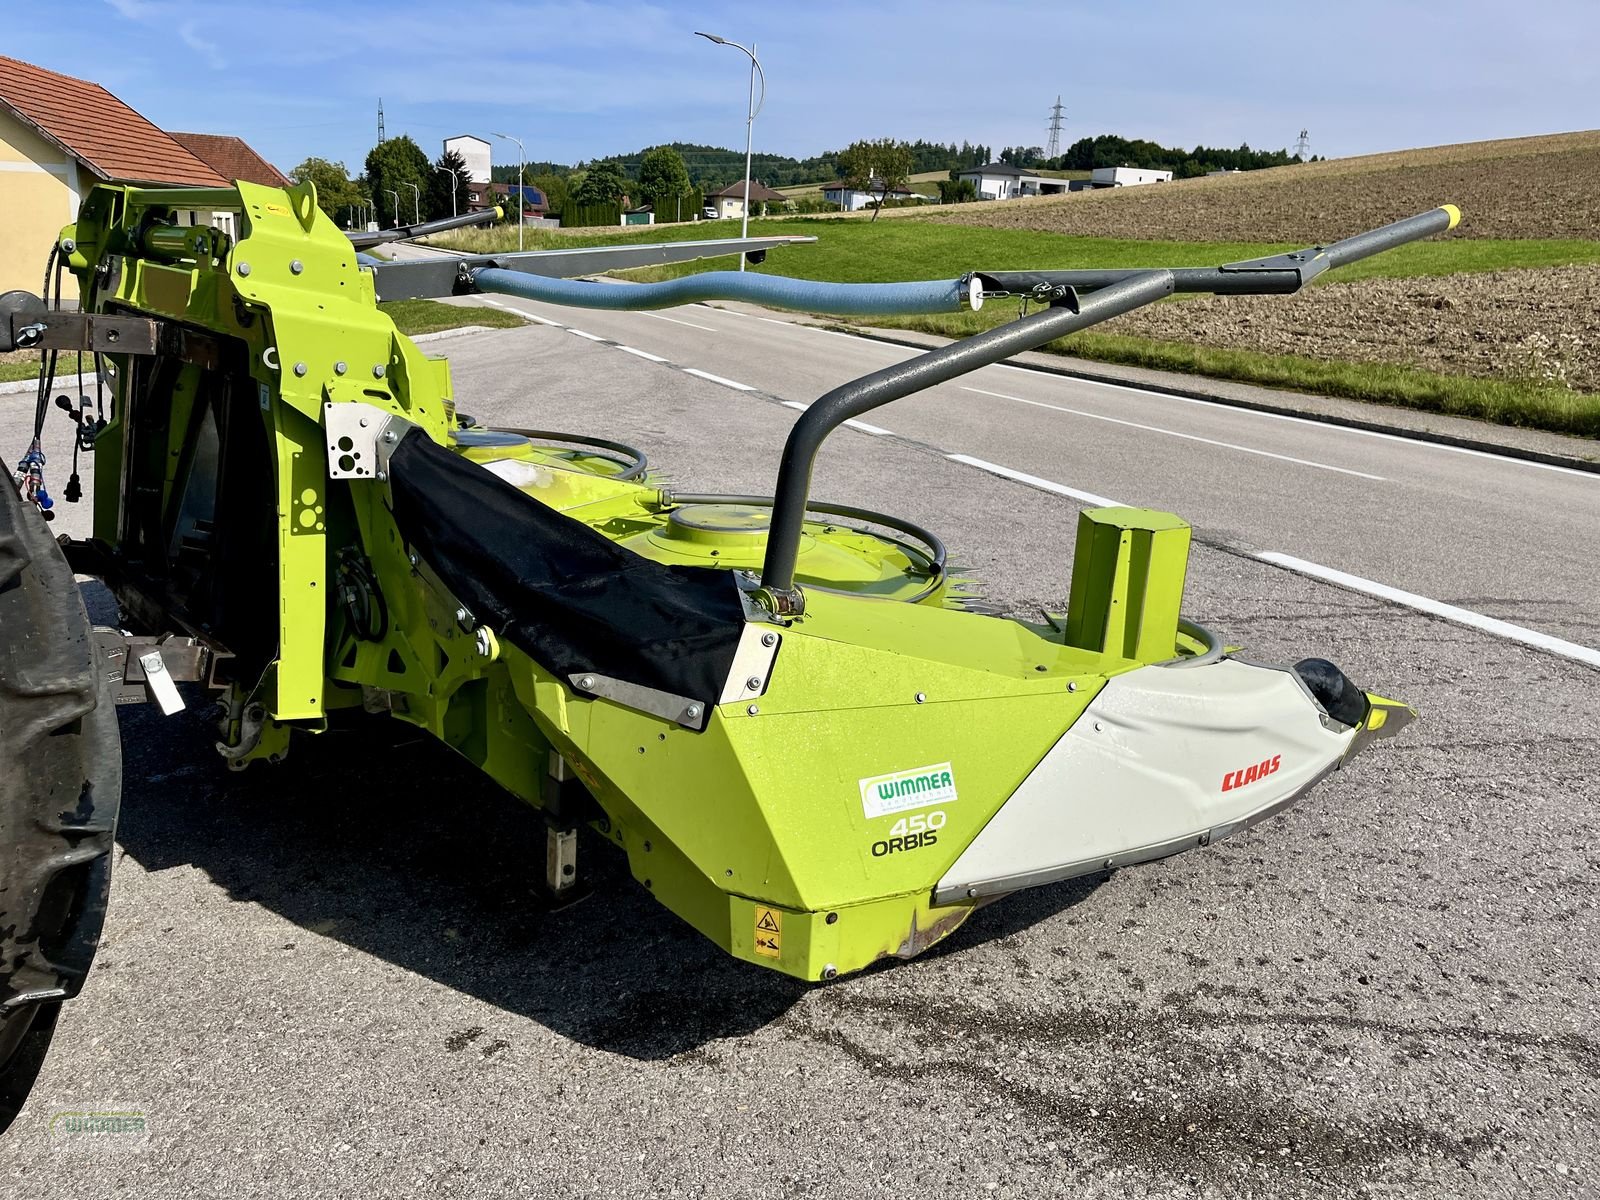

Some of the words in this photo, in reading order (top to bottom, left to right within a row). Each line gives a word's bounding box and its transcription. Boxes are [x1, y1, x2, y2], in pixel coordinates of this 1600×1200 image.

[877, 771, 952, 800] WIMMER
[1221, 754, 1281, 792] CLAAS
[889, 810, 947, 836] 450
[871, 829, 938, 857] ORBIS
